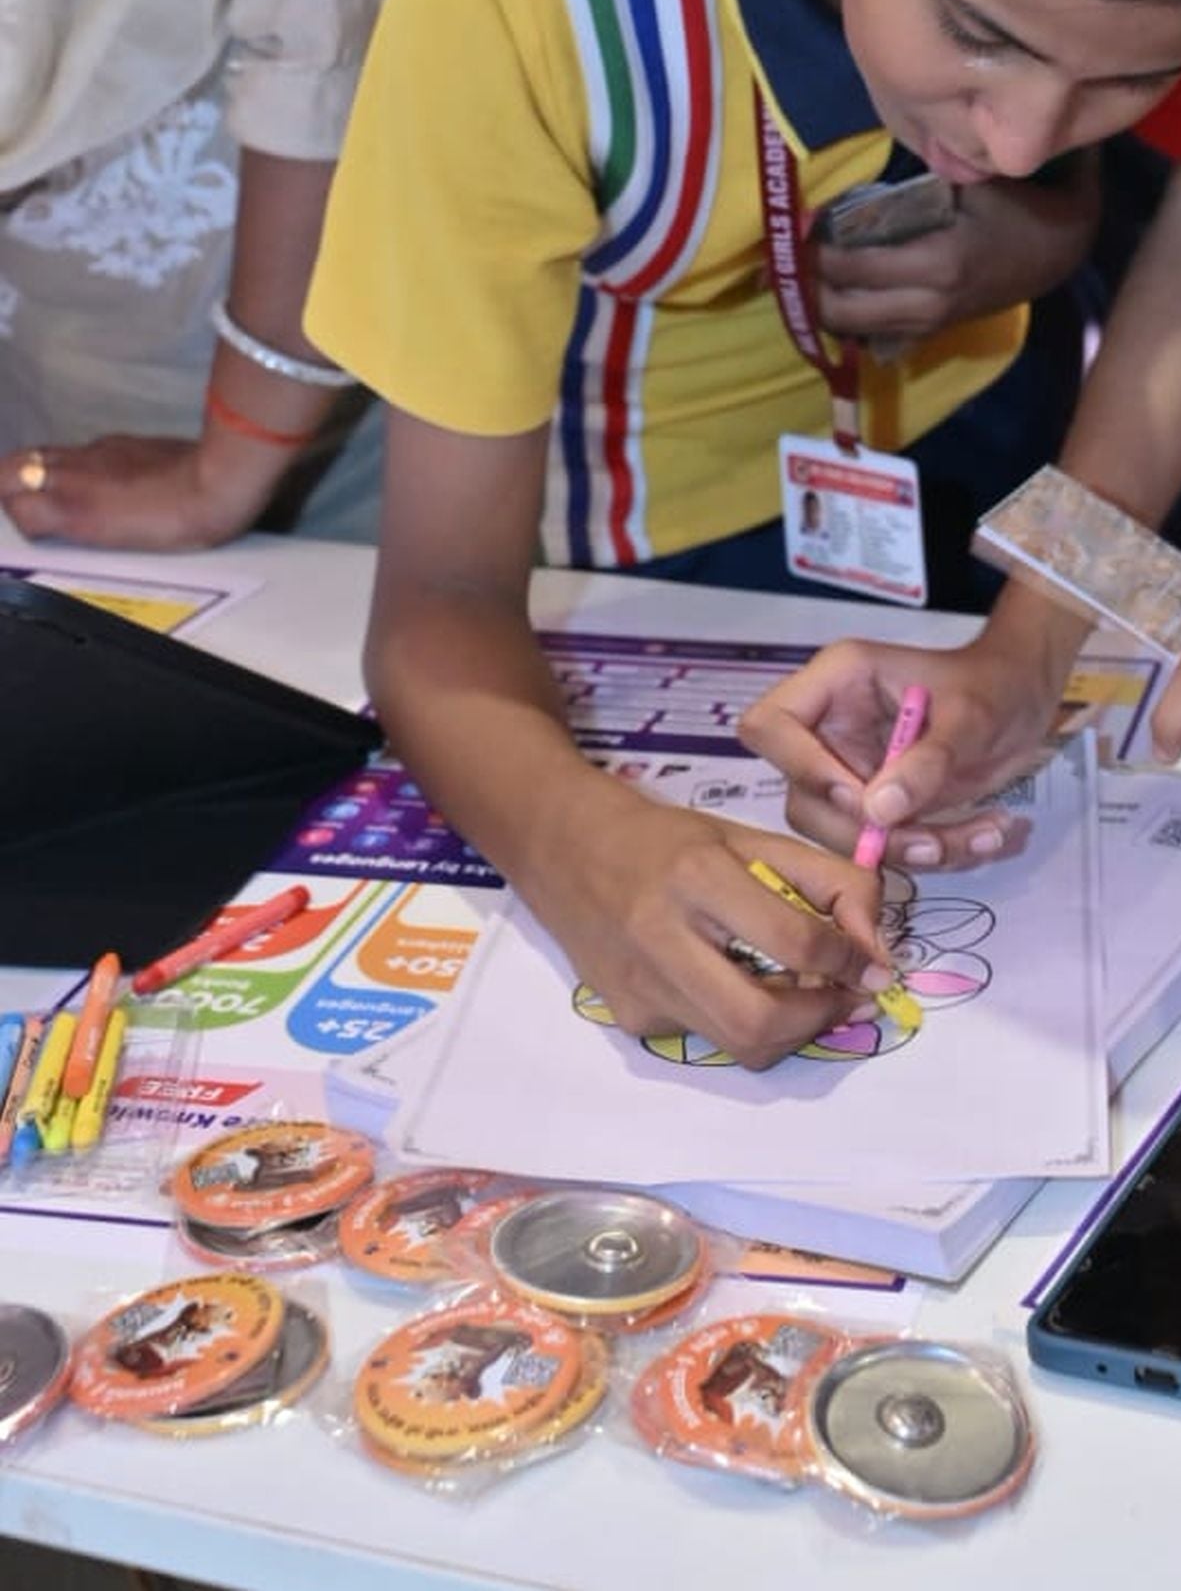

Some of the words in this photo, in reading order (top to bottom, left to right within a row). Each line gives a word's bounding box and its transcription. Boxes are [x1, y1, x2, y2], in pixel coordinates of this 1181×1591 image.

[769, 212, 796, 276] GIRLS
[309, 852, 430, 873] Languages
[316, 1016, 395, 1041] 25+
[139, 1080, 225, 1101] FREE
